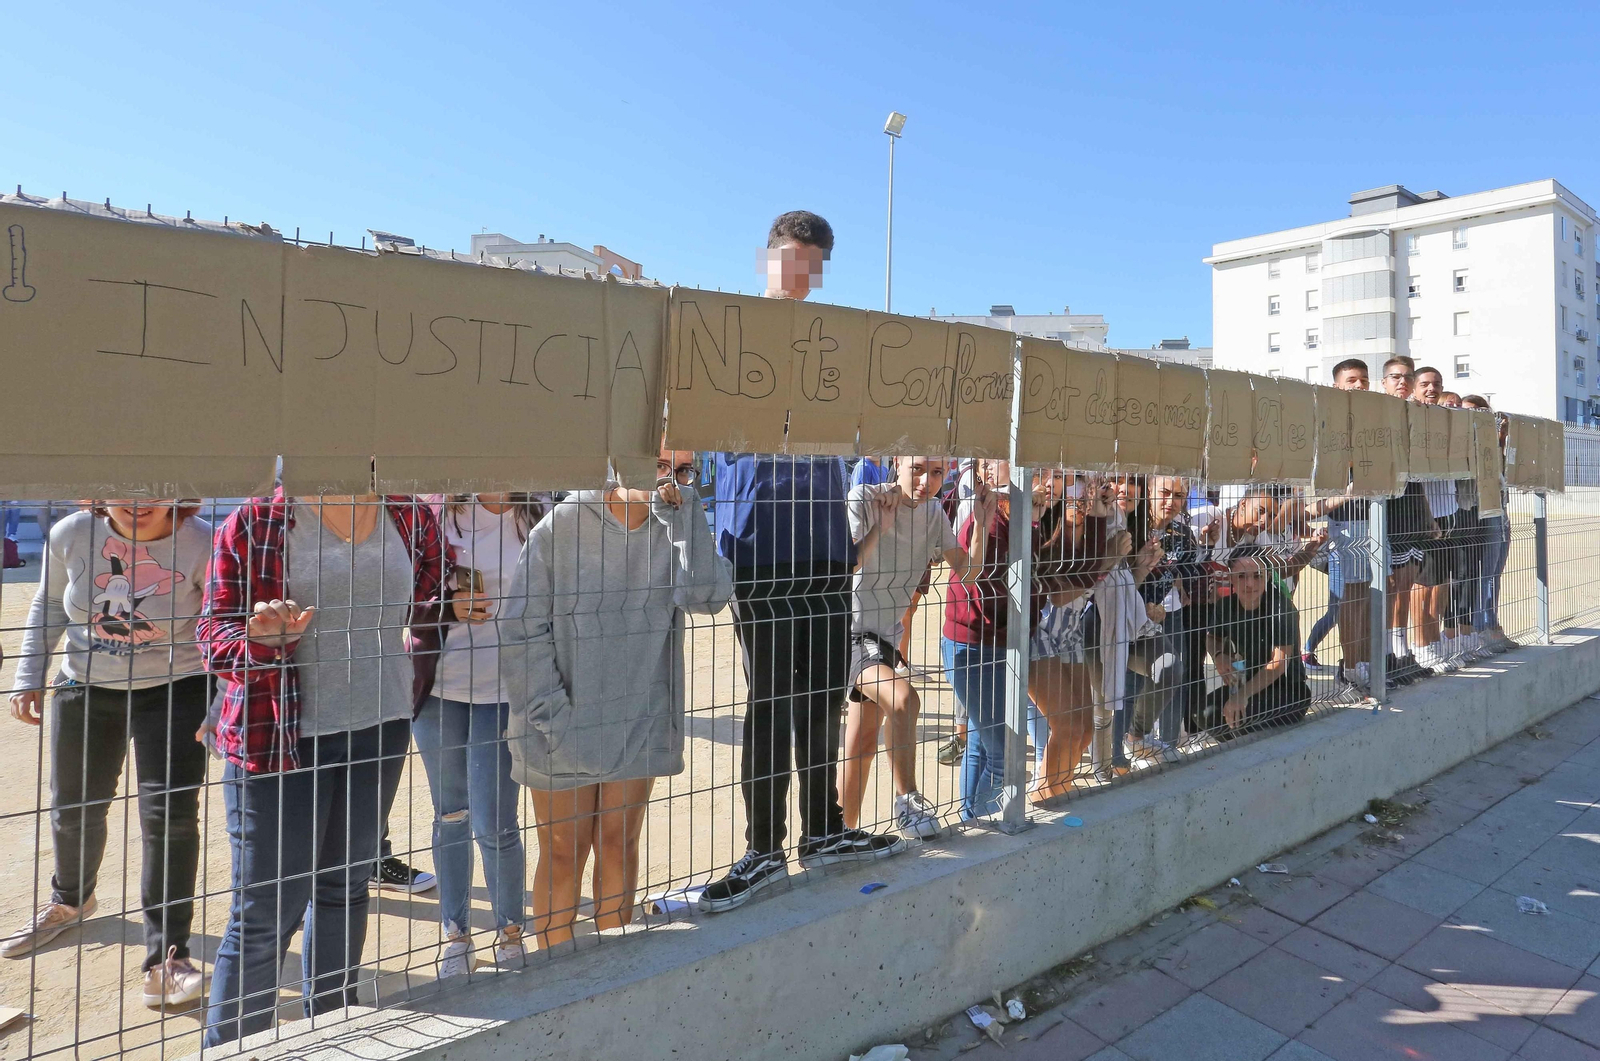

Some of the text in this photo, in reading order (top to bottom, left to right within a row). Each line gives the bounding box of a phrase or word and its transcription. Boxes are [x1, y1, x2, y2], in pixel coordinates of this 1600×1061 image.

[87, 278, 649, 405] INJUSTICIA
[676, 301, 776, 399] No
[791, 316, 841, 402] te
[1022, 355, 1081, 422] Dar
[1084, 367, 1142, 426] clase
[1145, 401, 1159, 426] a
[1163, 392, 1202, 430] más
[1212, 389, 1239, 447] de
[1287, 423, 1306, 452] es
